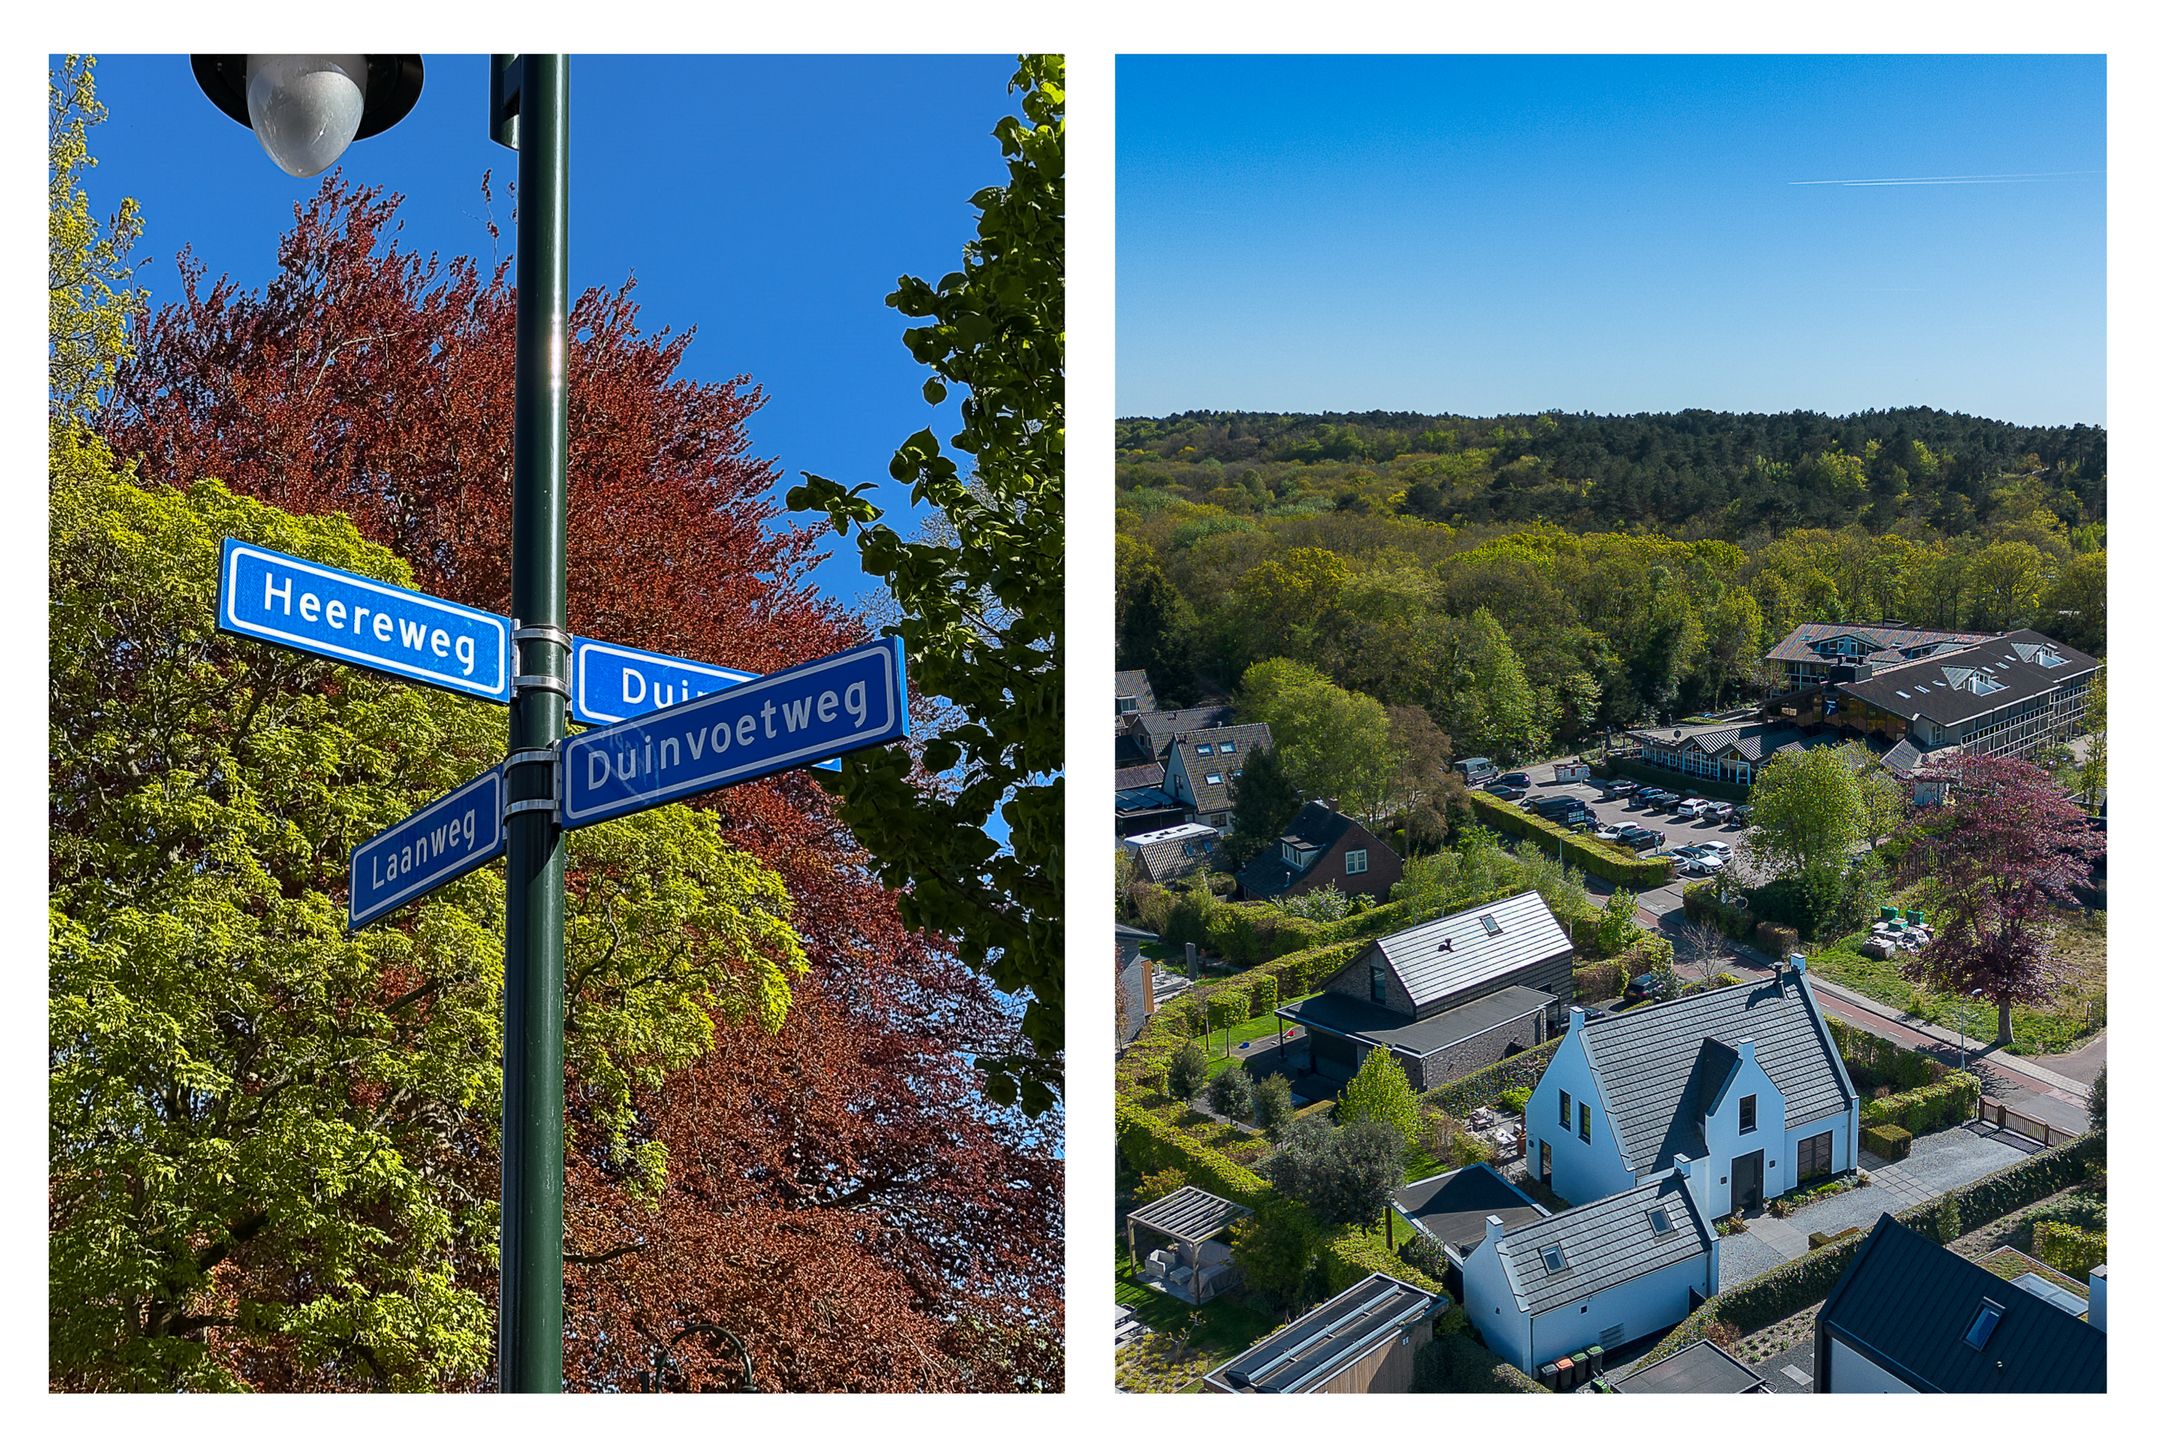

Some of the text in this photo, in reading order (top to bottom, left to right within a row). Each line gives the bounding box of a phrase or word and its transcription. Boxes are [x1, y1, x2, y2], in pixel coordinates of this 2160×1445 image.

[264, 572, 475, 676] Heereweg
[623, 667, 709, 709] Dui
[588, 679, 866, 791] Duinvoetweg
[372, 808, 476, 890] Laanweg
